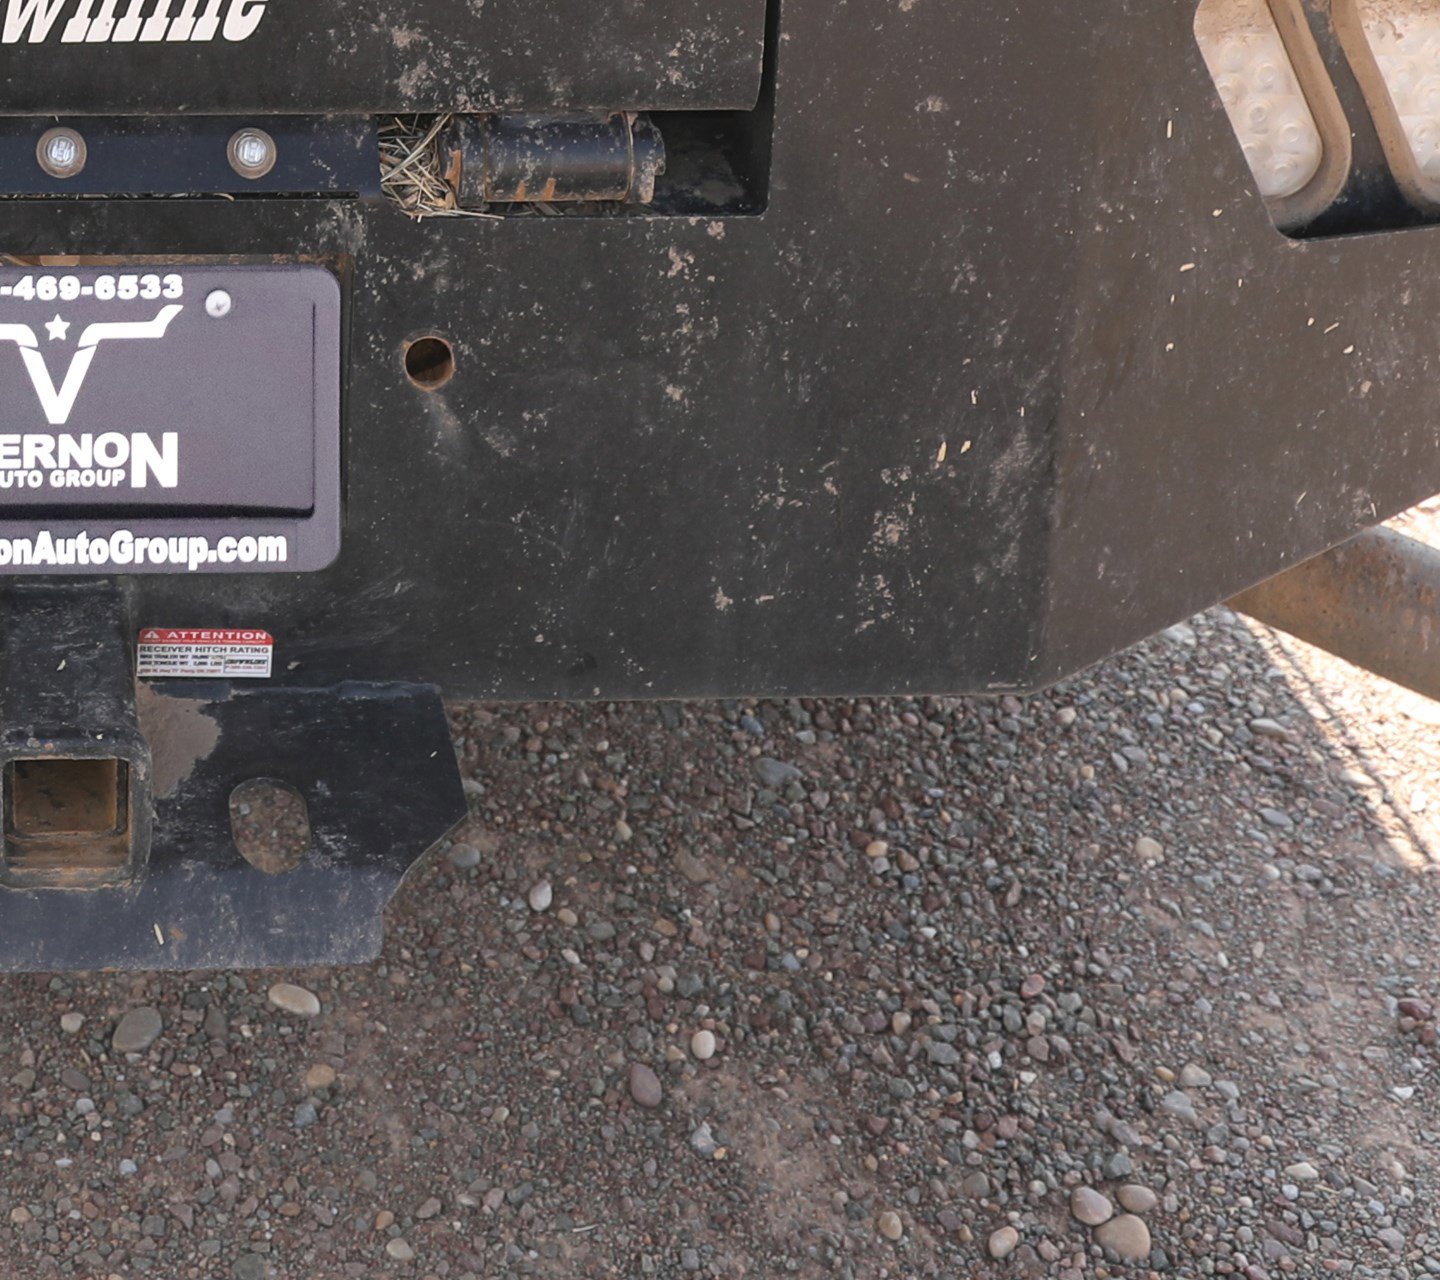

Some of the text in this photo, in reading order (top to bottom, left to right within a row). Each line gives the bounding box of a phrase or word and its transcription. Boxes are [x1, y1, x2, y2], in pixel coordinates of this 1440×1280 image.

[50, 469, 126, 489] GROUP
[167, 631, 267, 640] ATTENTION
[140, 645, 193, 653] RECEIVER
